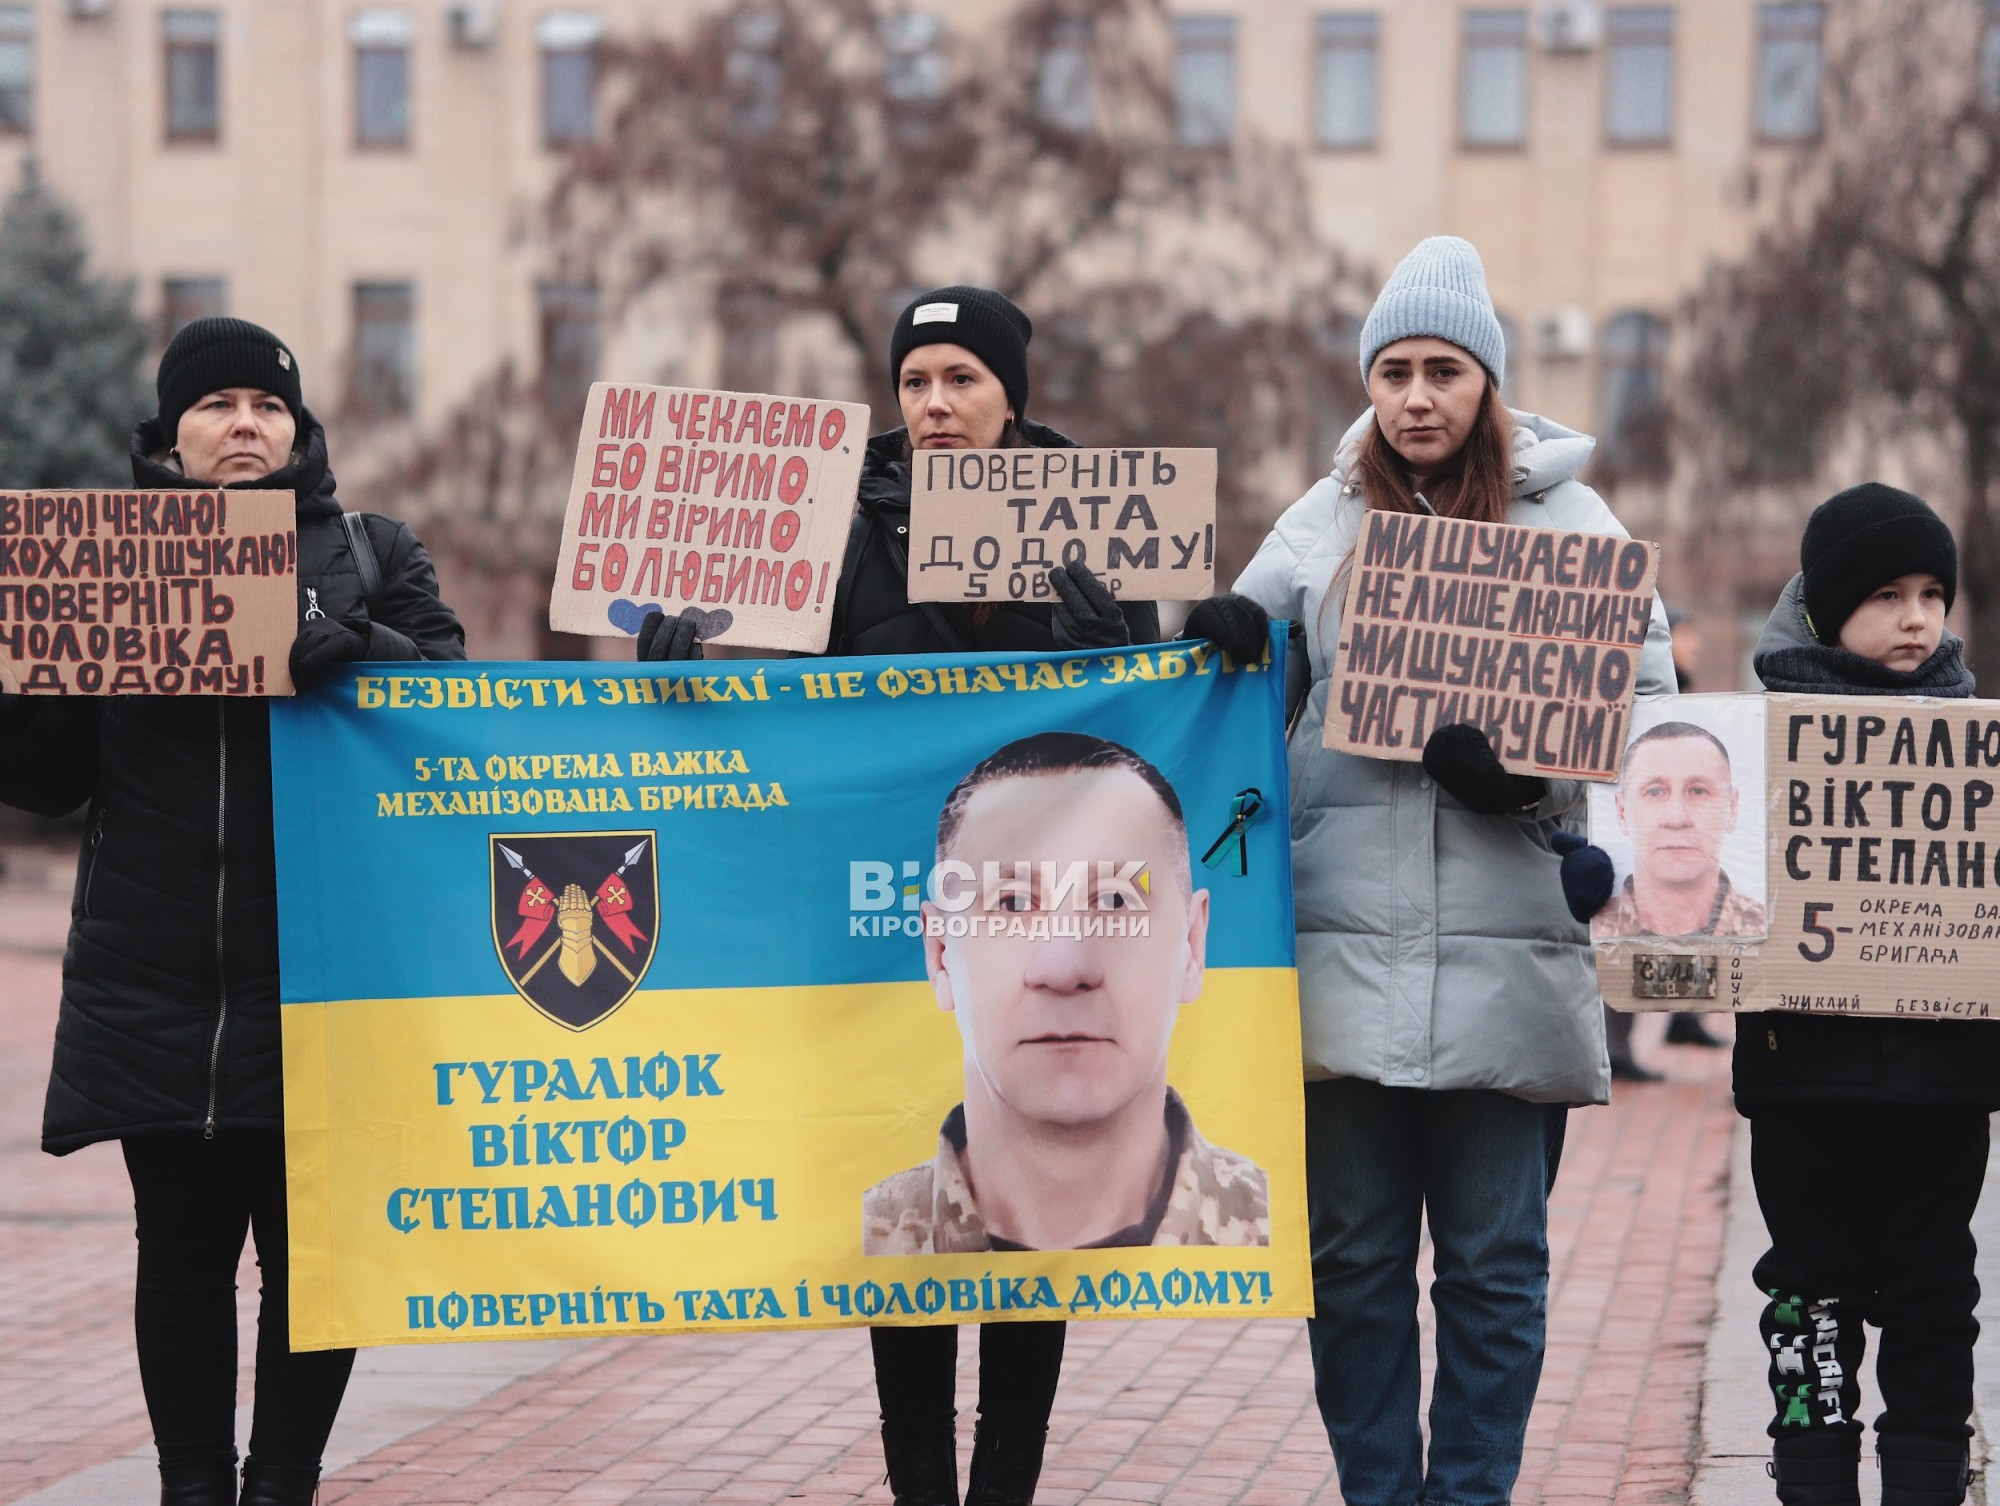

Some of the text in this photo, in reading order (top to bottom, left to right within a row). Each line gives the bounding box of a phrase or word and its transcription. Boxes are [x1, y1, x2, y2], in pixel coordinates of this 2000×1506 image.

[599, 388, 656, 439] МИ
[591, 441, 813, 505] БО ВІРИМО.
[927, 450, 1177, 491] ПОВЕРНІТЬ
[0, 490, 227, 537] ВІРЮ! ЧЕКАЮ!
[578, 492, 800, 553] МИ ВІРИМО
[1007, 495, 1158, 533] ТАТА
[0, 530, 296, 579] КОХАЮ! ШУКАЮ!
[919, 523, 1213, 571] ДОДОМУ!
[1363, 512, 1648, 593] МИ ШУКАЄМО
[0, 577, 235, 626] ПОВЕРНІТЬ
[572, 543, 830, 614] БО ЛЮБИМО!
[964, 573, 988, 597] 5
[1354, 570, 1652, 645] НЕ ЛИШЕ ЛЮДИНУ
[0, 624, 233, 668] ЧОЛОВІКА
[1406, 629, 1630, 702] ШУКАЄМО
[20, 655, 265, 695] ДОДОМУ!
[355, 672, 588, 711] БЕЗВІСТИ
[593, 668, 771, 706] ЗНИКЛІ
[800, 671, 866, 700] НЕ
[877, 657, 1090, 700] ОЗНАЧАЄ
[1534, 696, 1627, 771] СІМЇ
[415, 749, 750, 782] 5-ТА ОКРЕМА ВАЖКА
[376, 782, 789, 817] МЕХАНІЗОВАНА БРИГАДА
[1789, 777, 1994, 832] ВІКТОР
[1859, 899, 1942, 917] ОКРЕМА
[1859, 945, 1959, 964] БРИГАДА
[1778, 993, 1989, 1018] ЗНИКЛИЙ БЕЗВІСТИ
[432, 1050, 725, 1106] ГУРАЛЮК
[467, 1113, 686, 1168] ВІКТОР
[386, 1177, 779, 1235] СТЕПАНОВИЧ
[405, 1285, 665, 1330] ПОВЕРНІТЬ
[674, 1287, 787, 1320] ТАТА
[822, 1271, 1062, 1318] ЧОЛОВІКА
[1068, 1267, 1273, 1314] ДОДОМУ!
